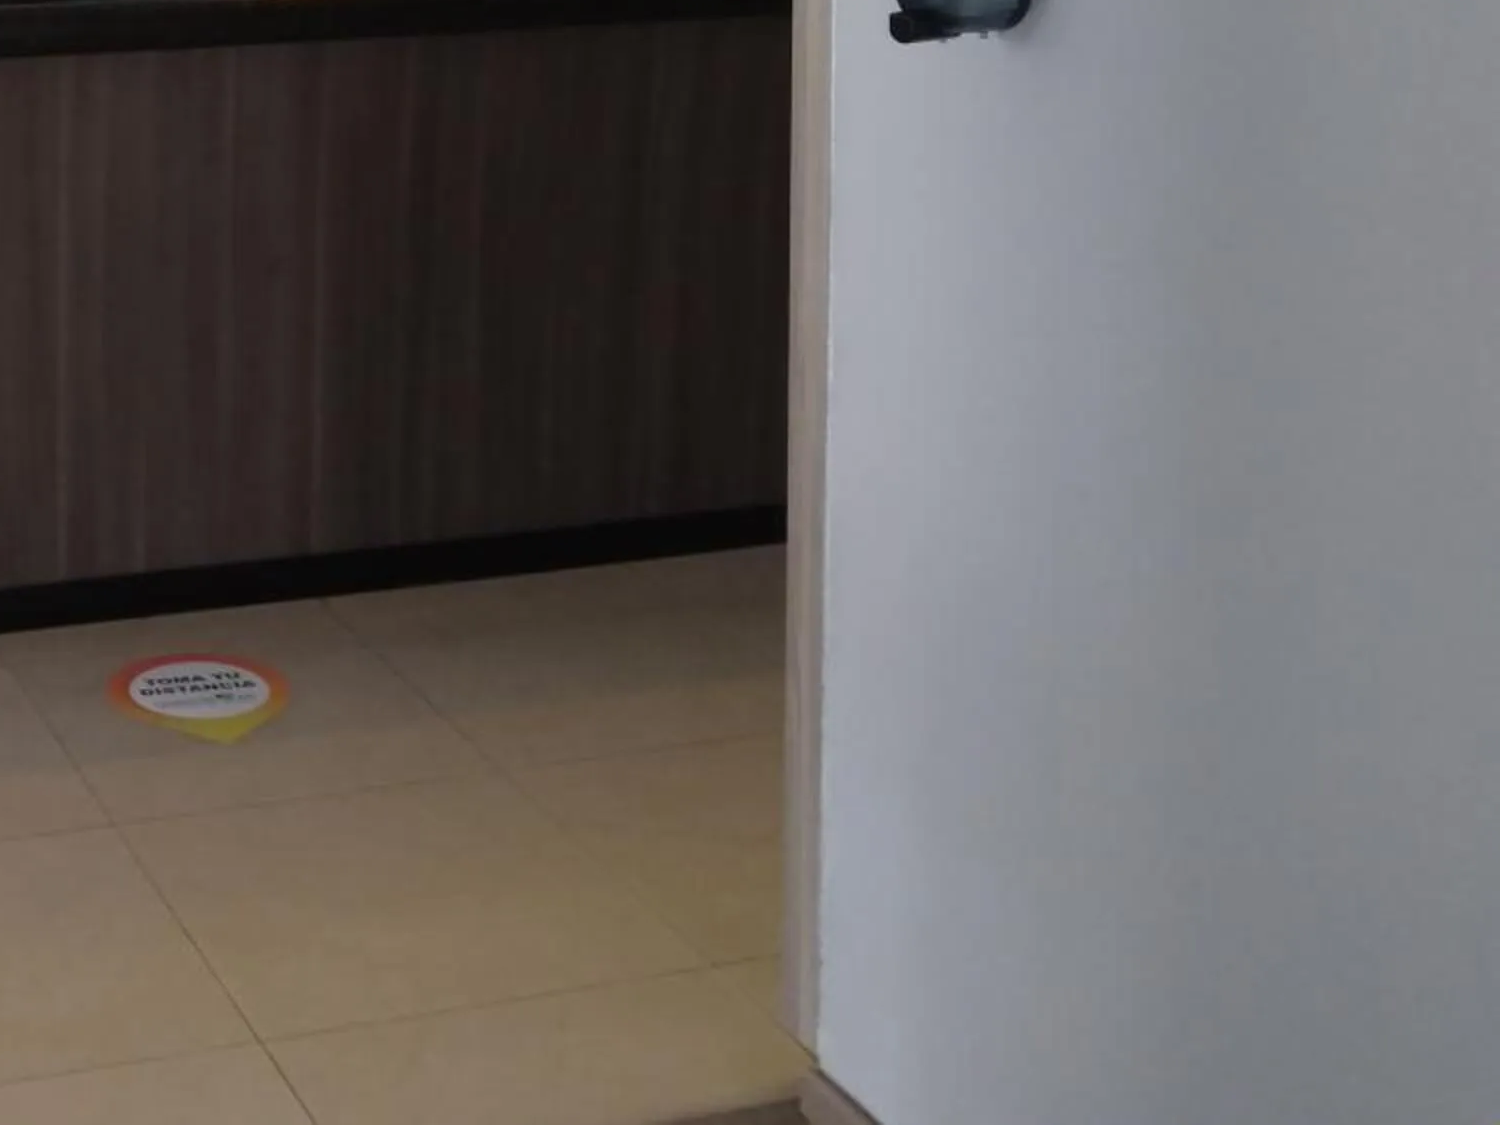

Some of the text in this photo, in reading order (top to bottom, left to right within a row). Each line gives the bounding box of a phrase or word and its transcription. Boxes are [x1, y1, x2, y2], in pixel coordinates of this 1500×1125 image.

[145, 671, 241, 686] TOMA TU
[139, 681, 257, 696] DISTANCIA
